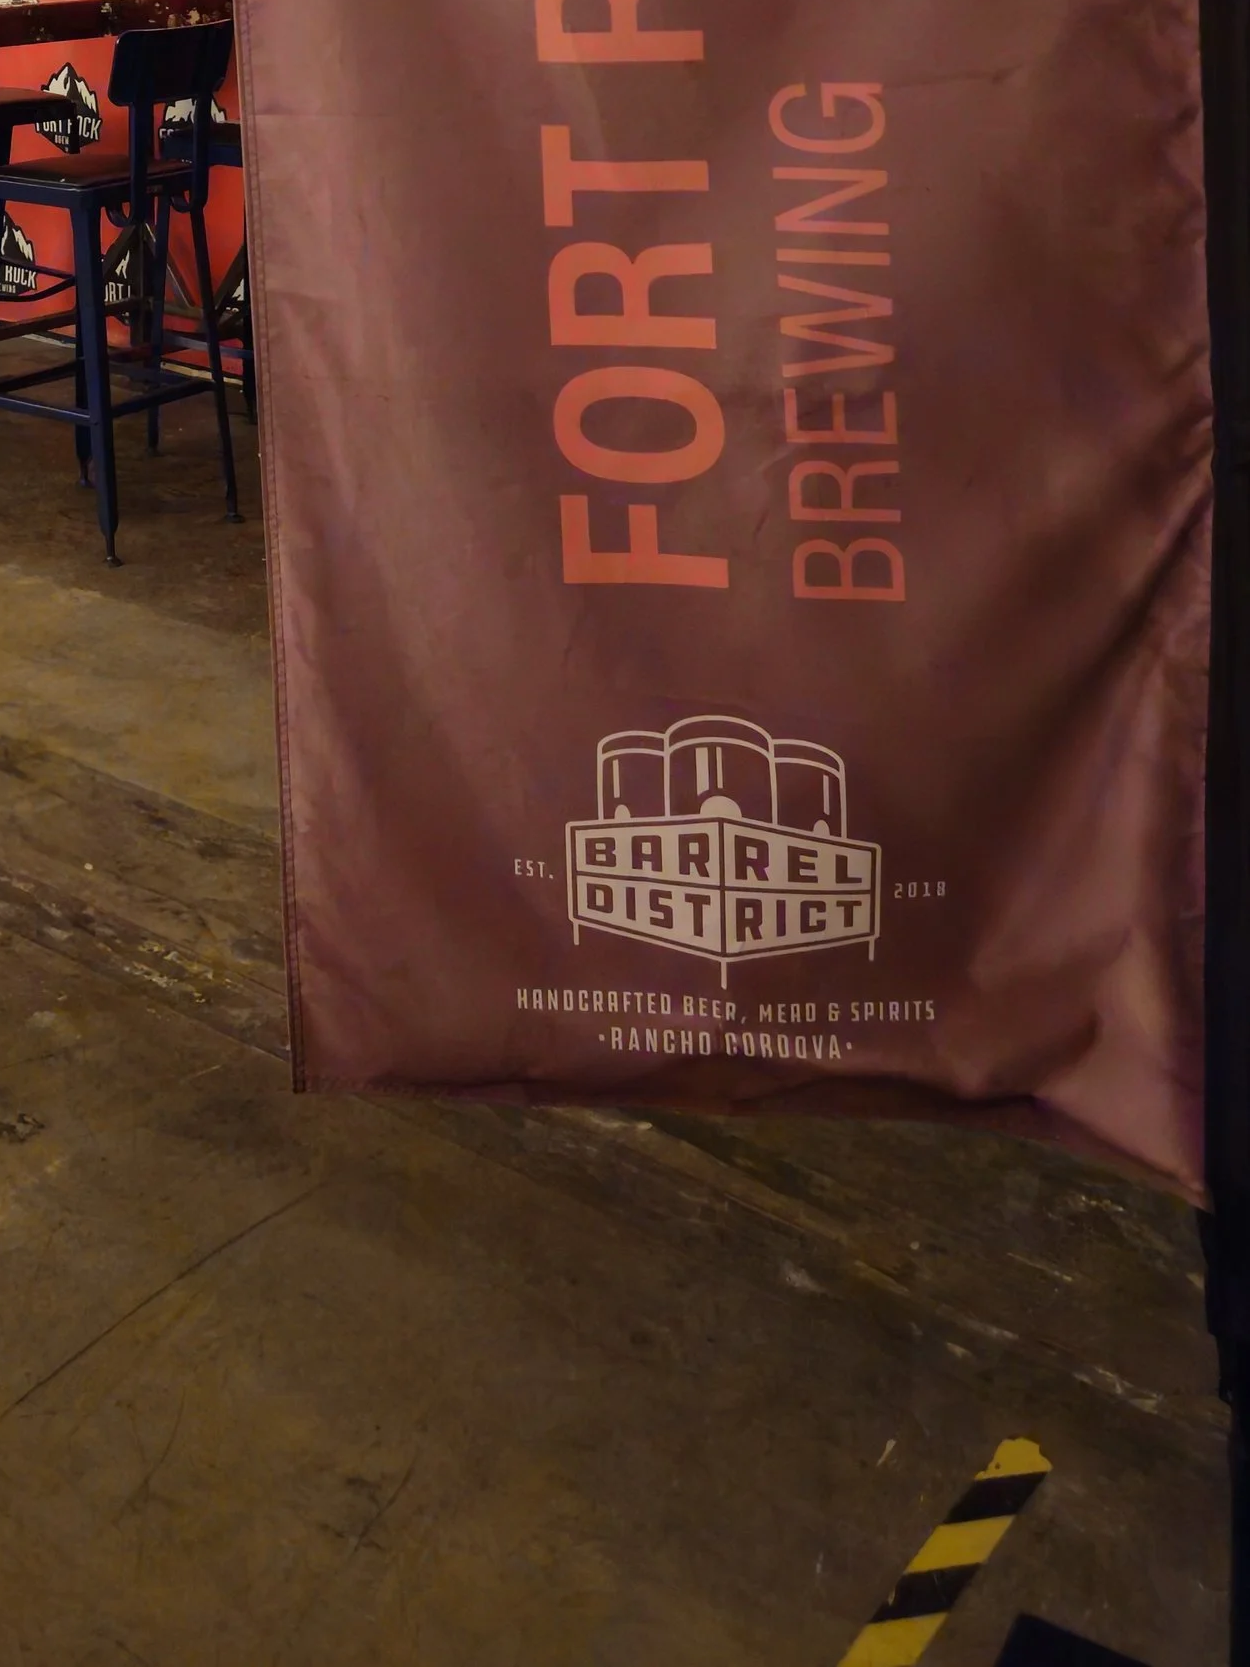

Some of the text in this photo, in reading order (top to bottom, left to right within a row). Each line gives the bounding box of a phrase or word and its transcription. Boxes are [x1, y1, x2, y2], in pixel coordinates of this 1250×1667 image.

[540, 125, 729, 588] FORT
[769, 81, 906, 604] BREWING
[513, 857, 554, 880] EST.
[583, 831, 864, 885] BARREL
[893, 879, 947, 899] 2018
[585, 883, 864, 944] DISTRICT
[516, 988, 936, 1024] HANDCRAFTED BEER, MEAD & SPIRITS
[610, 1026, 842, 1060] RANCHO CORDOVA
